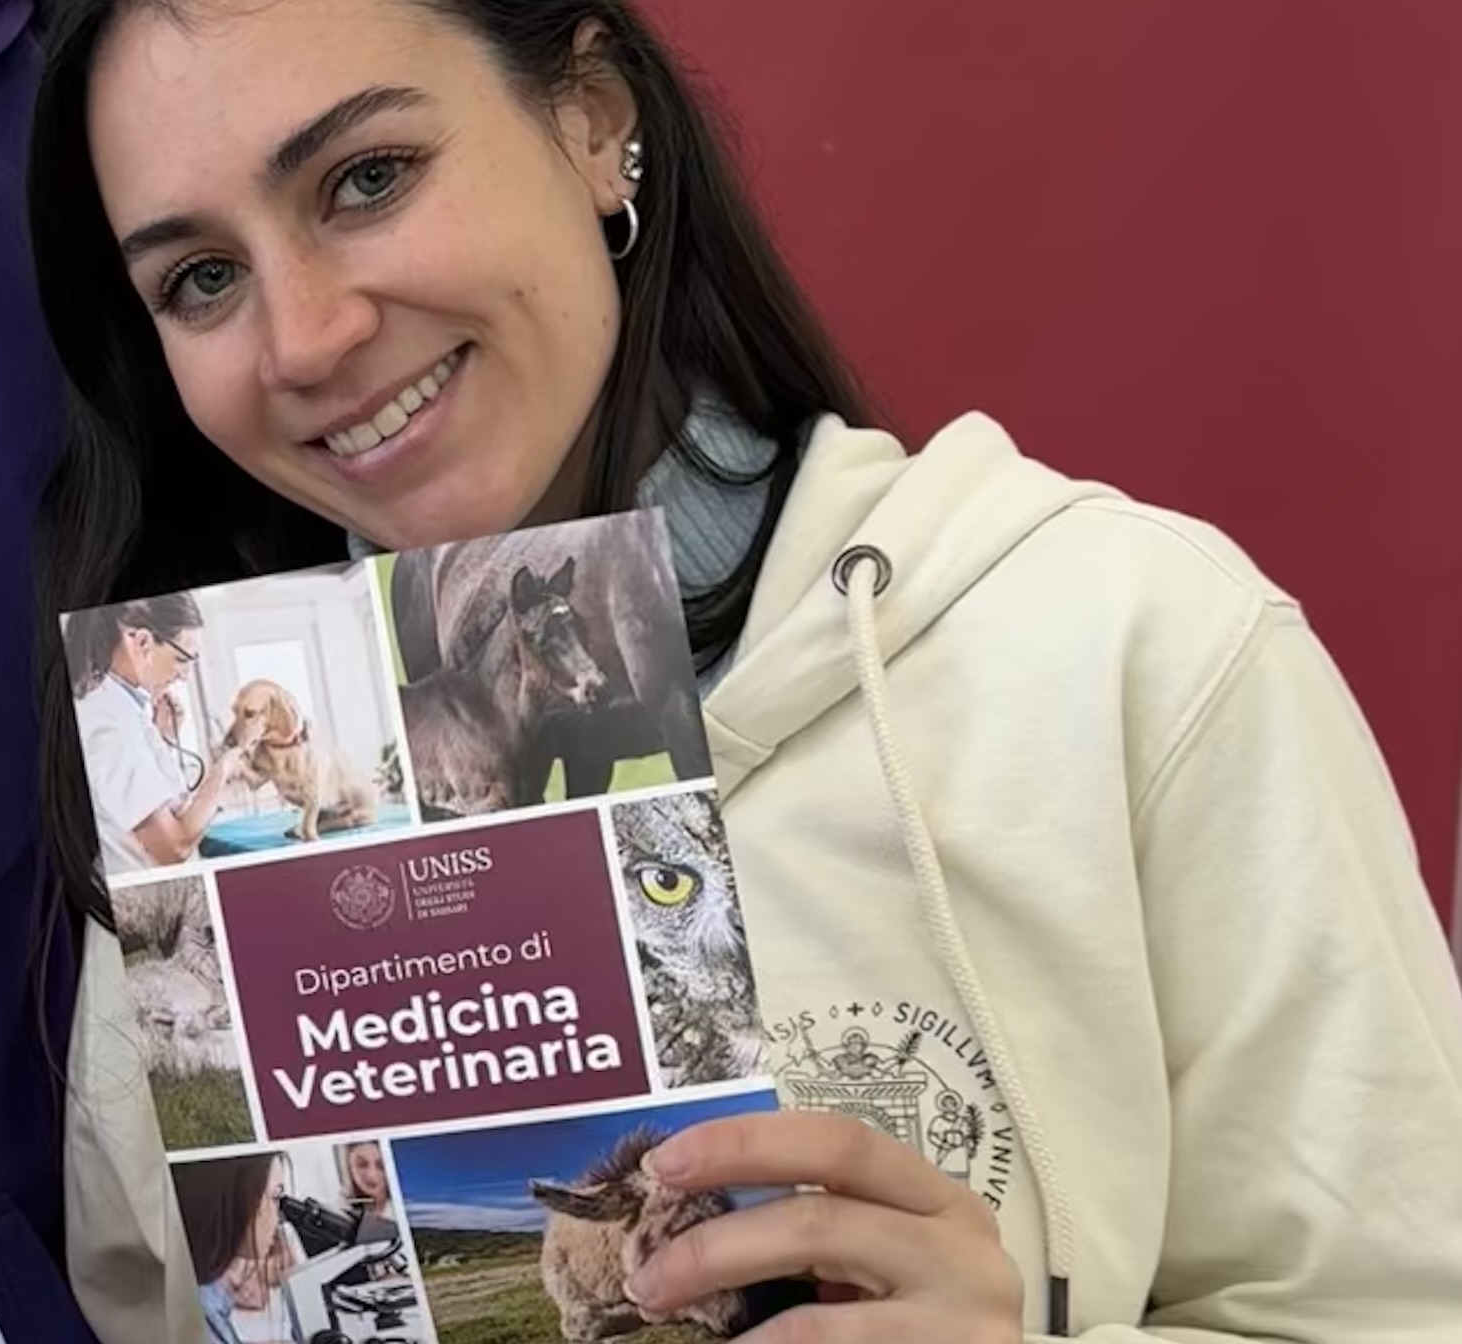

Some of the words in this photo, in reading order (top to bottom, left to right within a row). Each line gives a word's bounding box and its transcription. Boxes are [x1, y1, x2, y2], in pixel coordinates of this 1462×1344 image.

[407, 846, 494, 881] UNISS
[295, 935, 512, 996] Dipartimento
[520, 930, 553, 961] di
[296, 982, 581, 1058] Medicina
[892, 1001, 998, 1092] SIGILLVM
[273, 1024, 622, 1111] Veterinaria
[981, 1125, 1016, 1213] VNIVE
